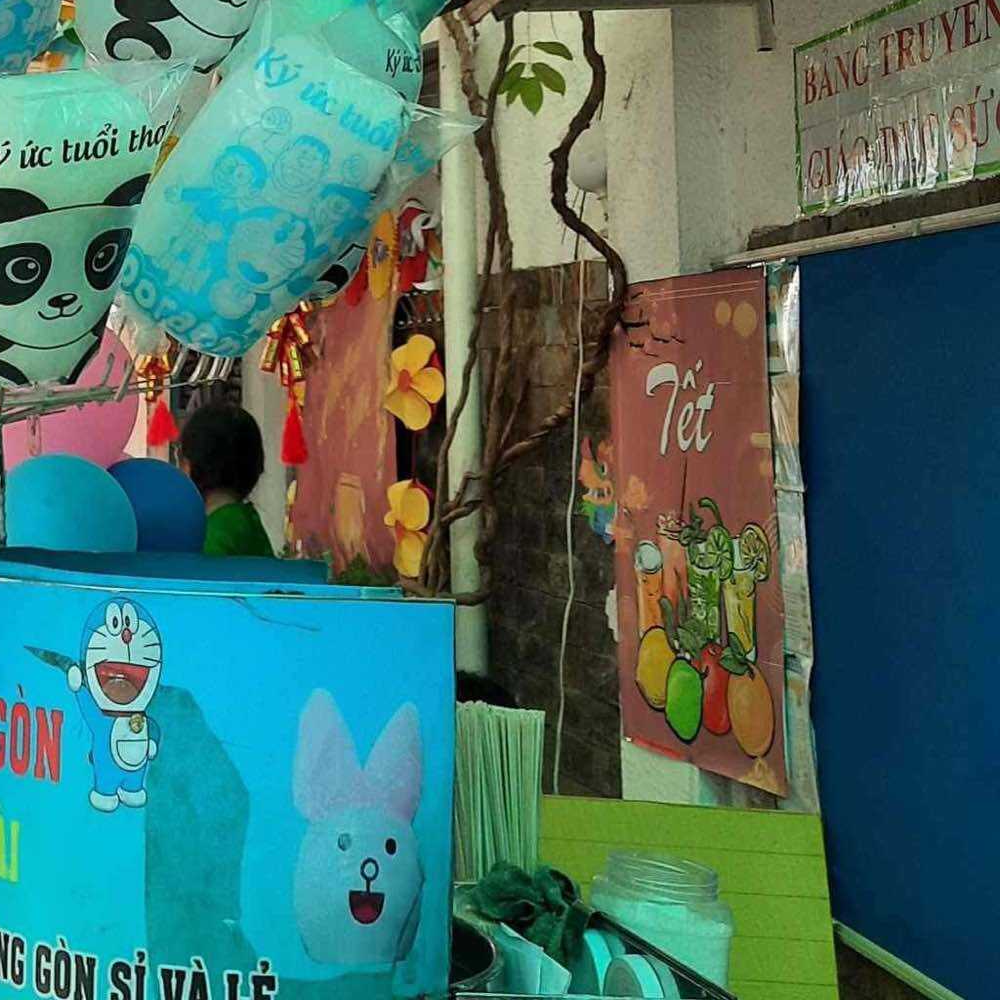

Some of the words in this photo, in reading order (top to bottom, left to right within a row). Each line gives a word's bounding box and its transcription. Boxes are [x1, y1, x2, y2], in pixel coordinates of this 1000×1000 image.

[255, 47, 302, 88] Ký
[19, 140, 53, 169] ức
[62, 123, 120, 164] tuổi
[128, 120, 170, 153] thơ
[646, 359, 716, 457] Tết
[34, 936, 97, 1000] GÒN
[110, 950, 147, 1000] SỈ
[160, 958, 212, 1000] VÀ
